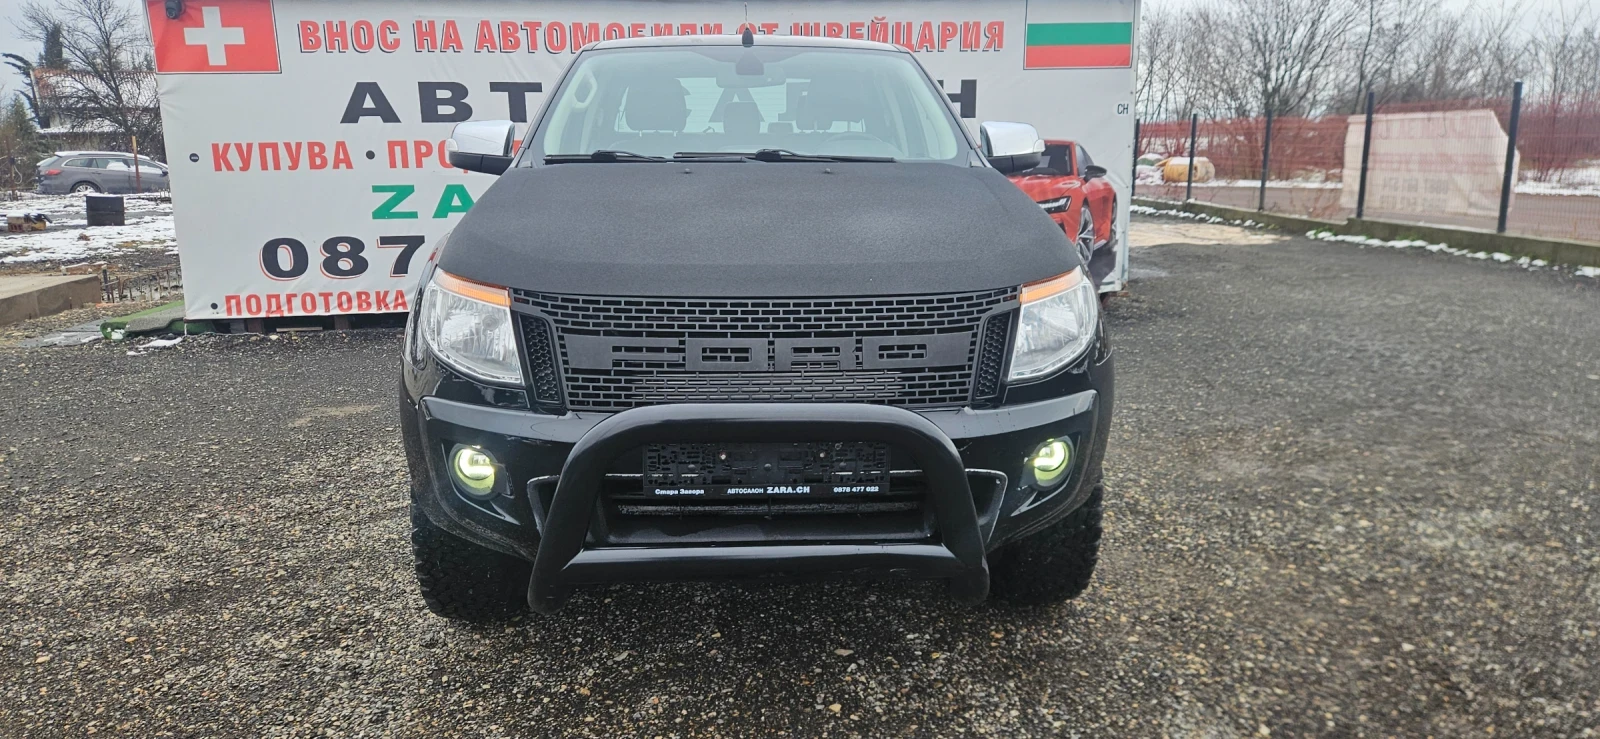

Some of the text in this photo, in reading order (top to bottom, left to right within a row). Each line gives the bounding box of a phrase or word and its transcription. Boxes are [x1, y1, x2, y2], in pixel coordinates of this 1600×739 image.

[297, 19, 401, 54] ВНОС
[413, 19, 464, 53] НА
[1117, 103, 1129, 115] CH
[211, 140, 354, 172] КУПУВА
[371, 184, 476, 220] ZA
[259, 235, 426, 282] 087
[224, 289, 409, 318] ПОДГОТОВКА
[563, 331, 975, 372] FORD
[766, 486, 811, 494] ZARA.CH
